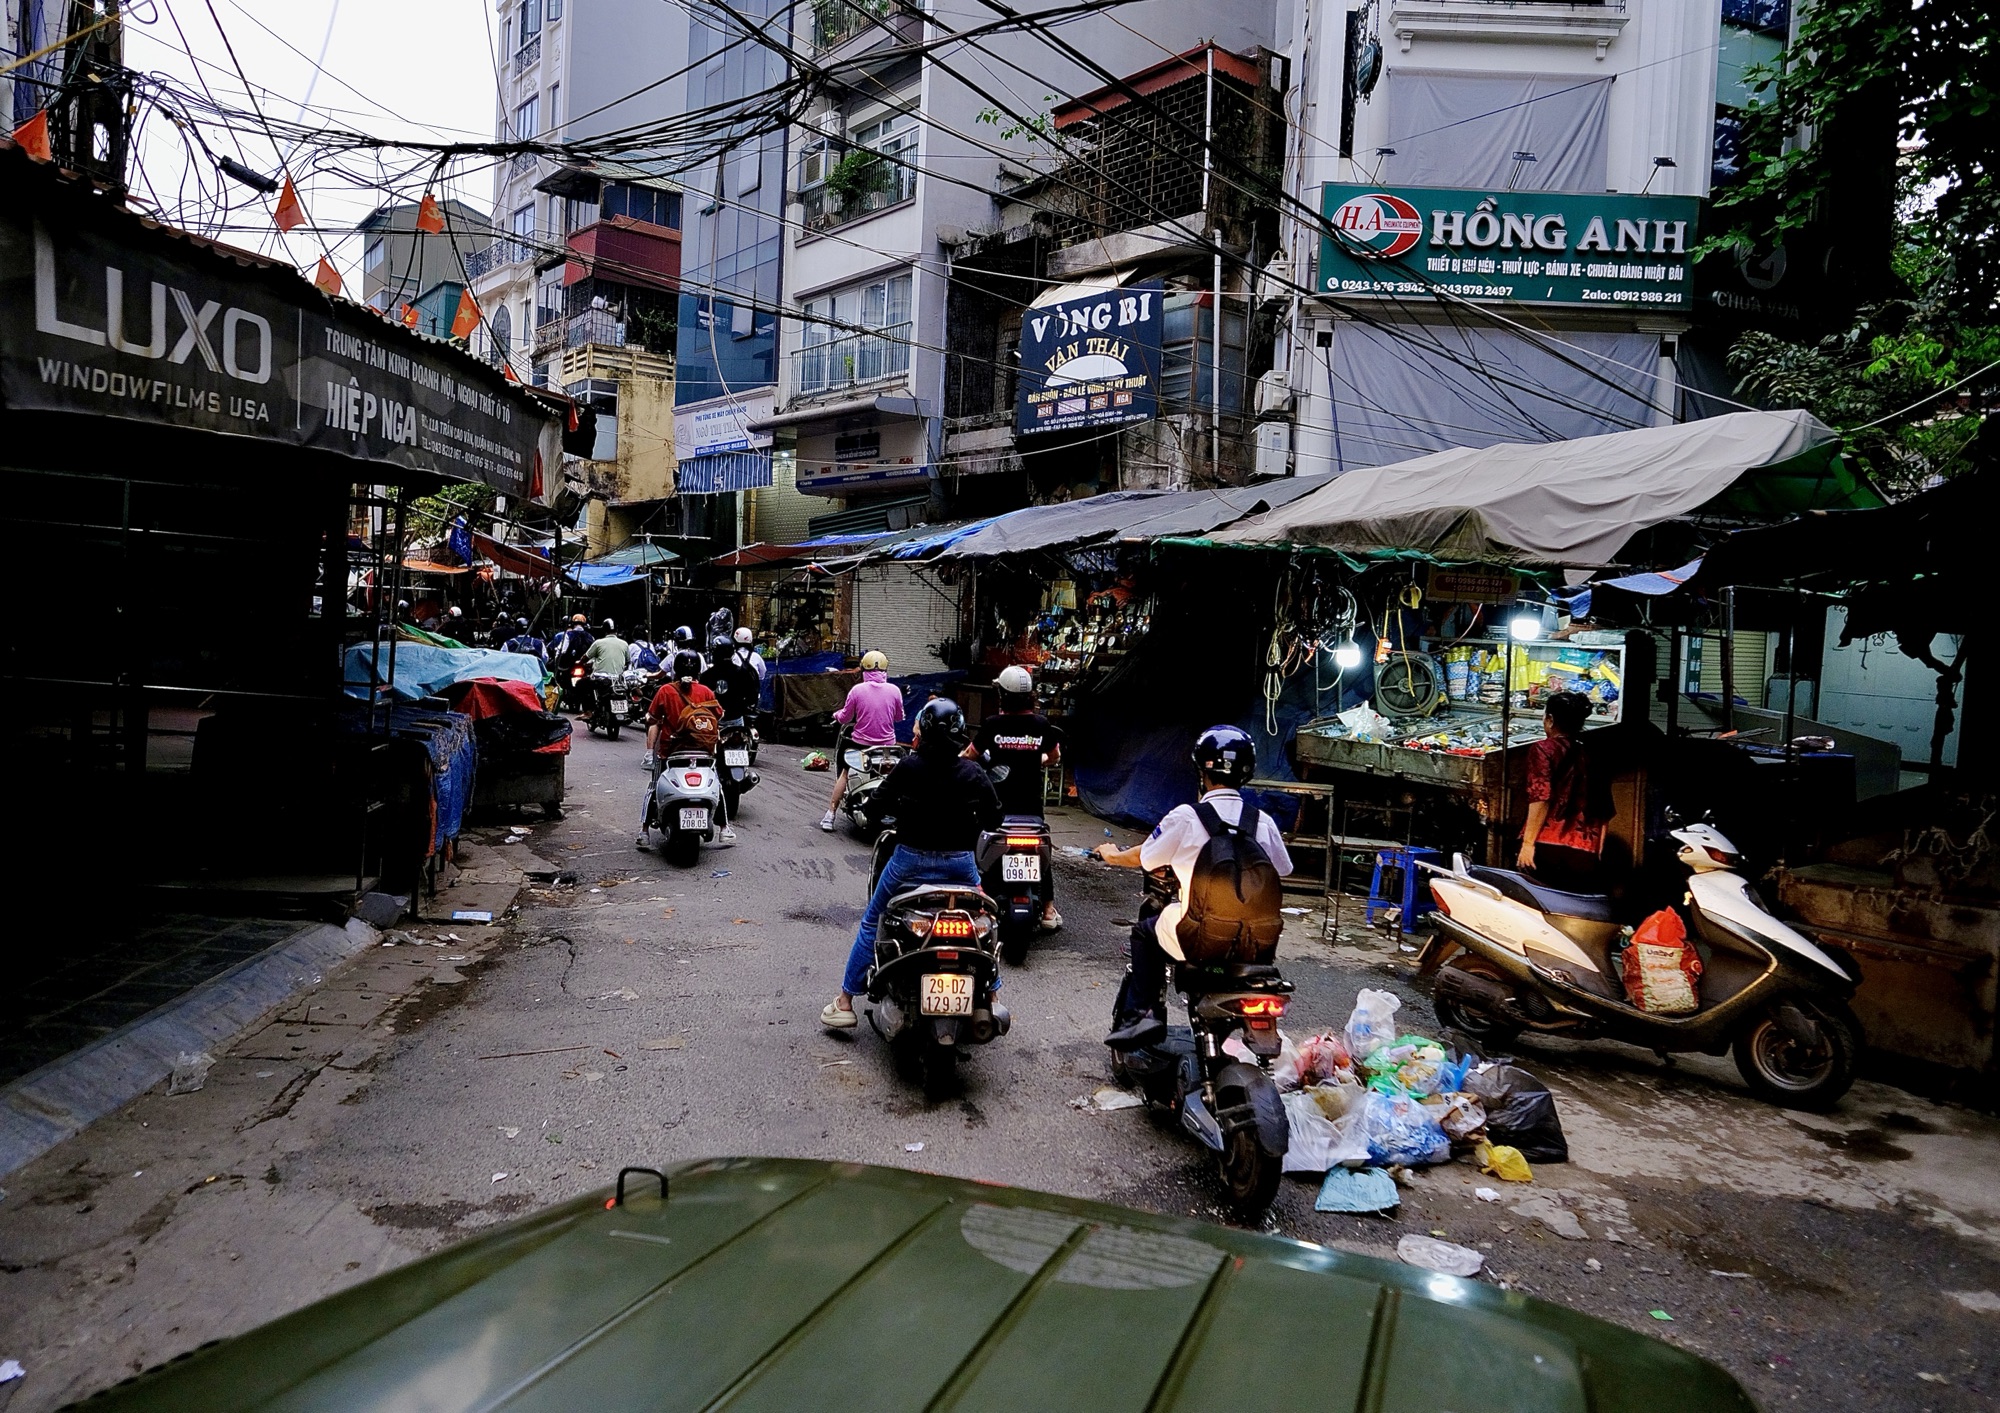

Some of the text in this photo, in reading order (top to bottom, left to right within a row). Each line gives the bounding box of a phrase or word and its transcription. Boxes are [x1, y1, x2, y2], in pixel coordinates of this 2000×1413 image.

[1340, 205, 1382, 231] H.A
[1429, 195, 1688, 254] HỒNG ANH
[1427, 253, 1451, 272] THIẾT
[1451, 258, 1461, 275] BỊ
[1461, 256, 1478, 273] KHÍ
[1477, 257, 1496, 274] NÉN
[1523, 260, 1540, 279] LỰC
[1545, 259, 1568, 276] BÁNH
[1569, 262, 1582, 277] XE
[1586, 262, 1619, 279] CHUYÊN
[1619, 263, 1643, 280] HÀNG
[1644, 263, 1666, 283] NHẬT
[1667, 264, 1684, 282] BÃI
[34, 222, 273, 385] LUXO
[1341, 279, 1370, 290] 0243
[1462, 284, 1484, 295] 978
[1484, 286, 1514, 297] 2497
[1581, 289, 1612, 301] Zalo:
[1613, 290, 1640, 301] 0912
[1640, 291, 1664, 302] 986
[1664, 293, 1683, 303] 211
[1030, 292, 1152, 343] VÒNG BI
[1044, 335, 1130, 372] VÂN THÁI
[36, 355, 271, 423] WINDOWFILMS USA
[325, 326, 362, 361] TRUNG
[363, 338, 387, 370] TÂM
[387, 351, 410, 379] KINH
[411, 361, 440, 392] DOANH
[457, 383, 478, 411] NGOẠI
[478, 392, 496, 417] THẤT
[495, 398, 501, 420] Ô
[501, 403, 511, 425] TÔ
[325, 375, 418, 447] HIỆP NGA
[681, 819, 707, 828] 208.05
[683, 810, 705, 820] 29-AD
[1005, 868, 1039, 880] 098.12
[1008, 856, 1035, 868] 29-AF
[929, 978, 966, 994] 29-D2
[926, 996, 971, 1013] 129.37
